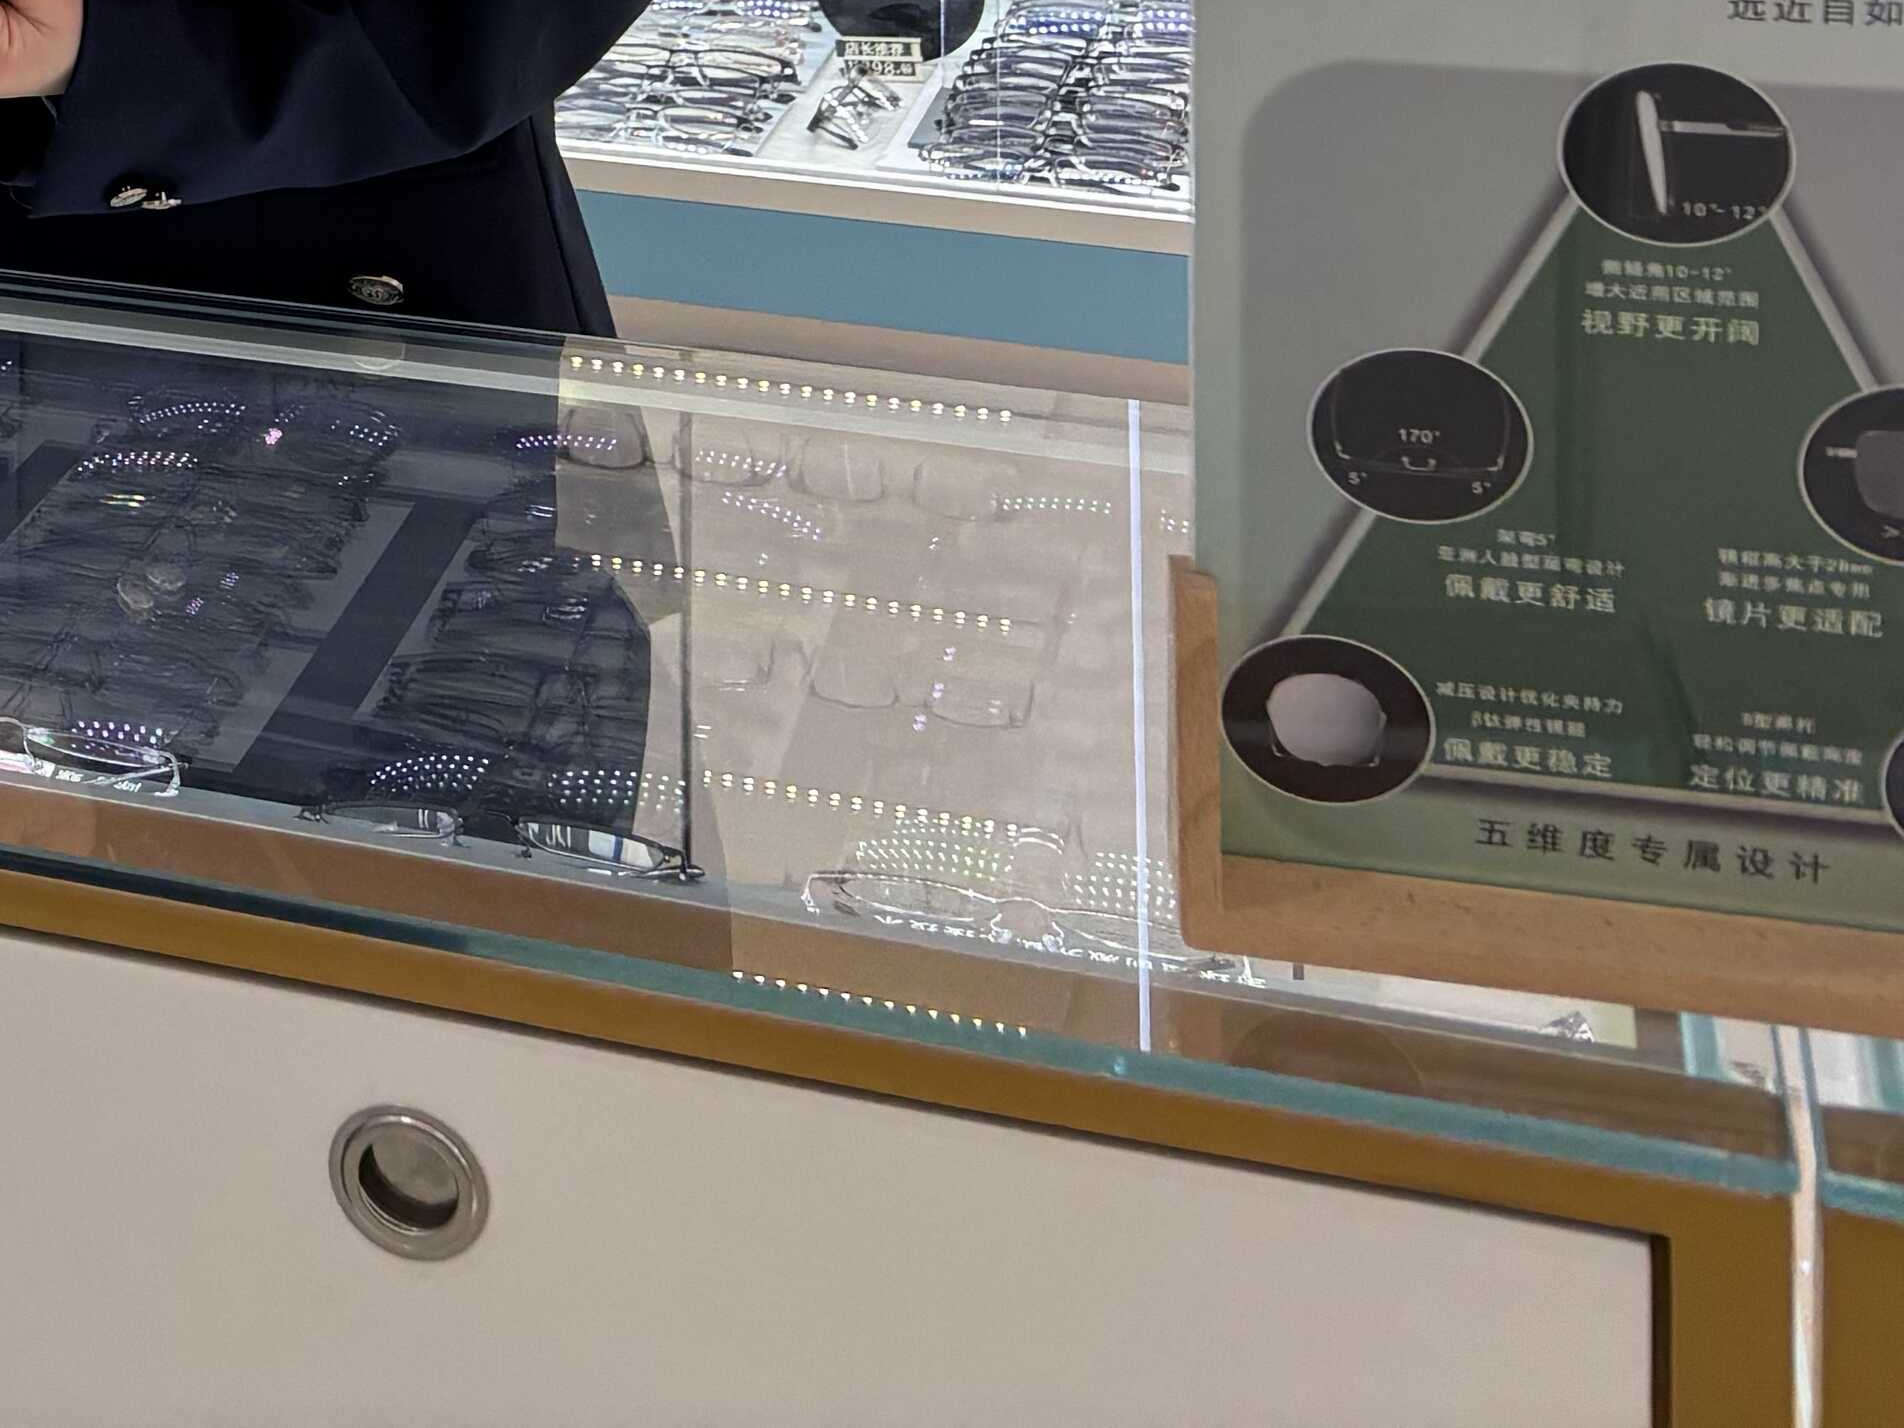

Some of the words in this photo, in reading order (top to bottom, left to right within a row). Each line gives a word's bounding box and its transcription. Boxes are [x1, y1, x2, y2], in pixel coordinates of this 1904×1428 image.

[1581, 309, 1761, 347] 视野更开阔
[1444, 573, 1616, 614] 佩戴更舒适
[1703, 596, 1884, 638] 镜片更适配
[1443, 737, 1613, 778] 佩戴更稳定
[1689, 764, 1863, 802] 定位更精准
[1475, 817, 1830, 885] 五维度专属设计
